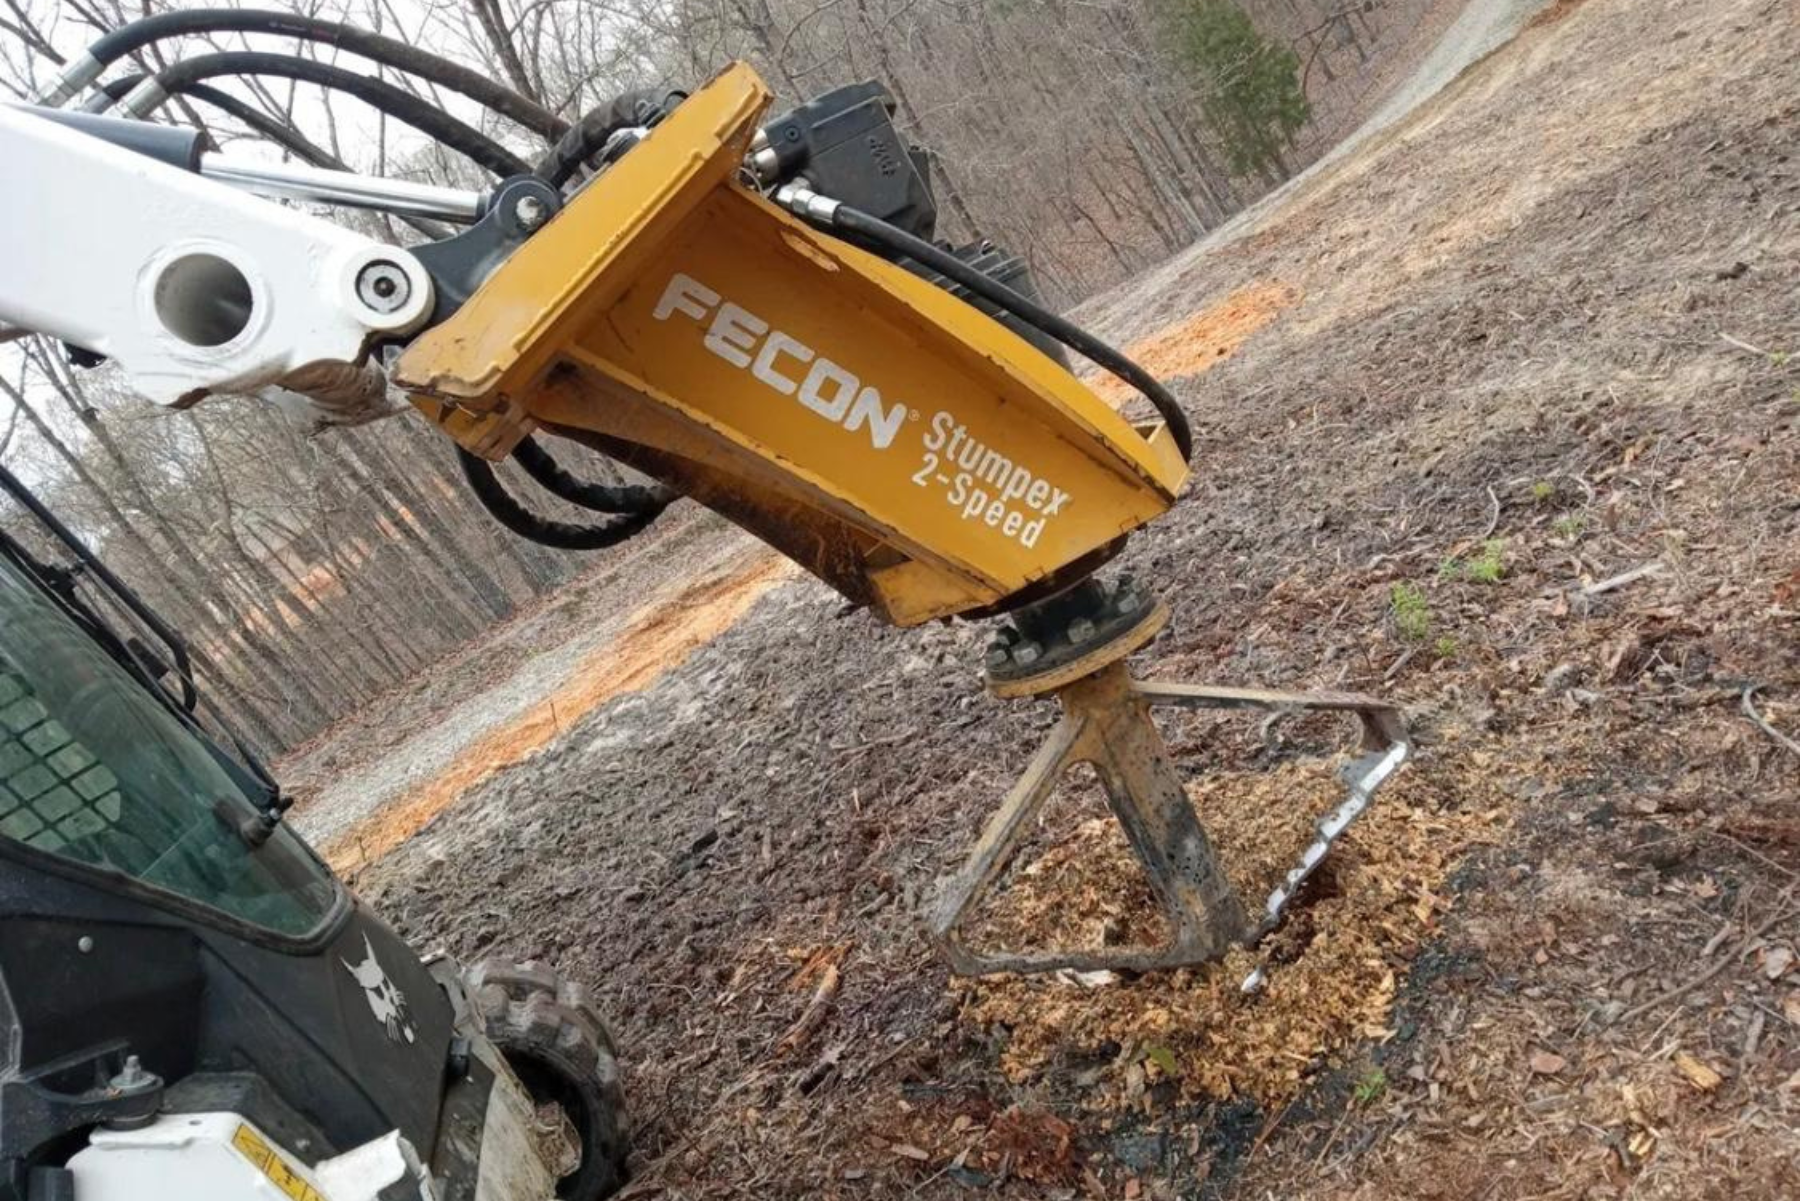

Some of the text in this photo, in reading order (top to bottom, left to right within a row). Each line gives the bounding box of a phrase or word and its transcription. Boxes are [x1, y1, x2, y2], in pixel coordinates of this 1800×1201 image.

[652, 272, 907, 449] FECON
[911, 452, 1046, 549] 2-Speed
[923, 411, 1070, 516] Stumpex
